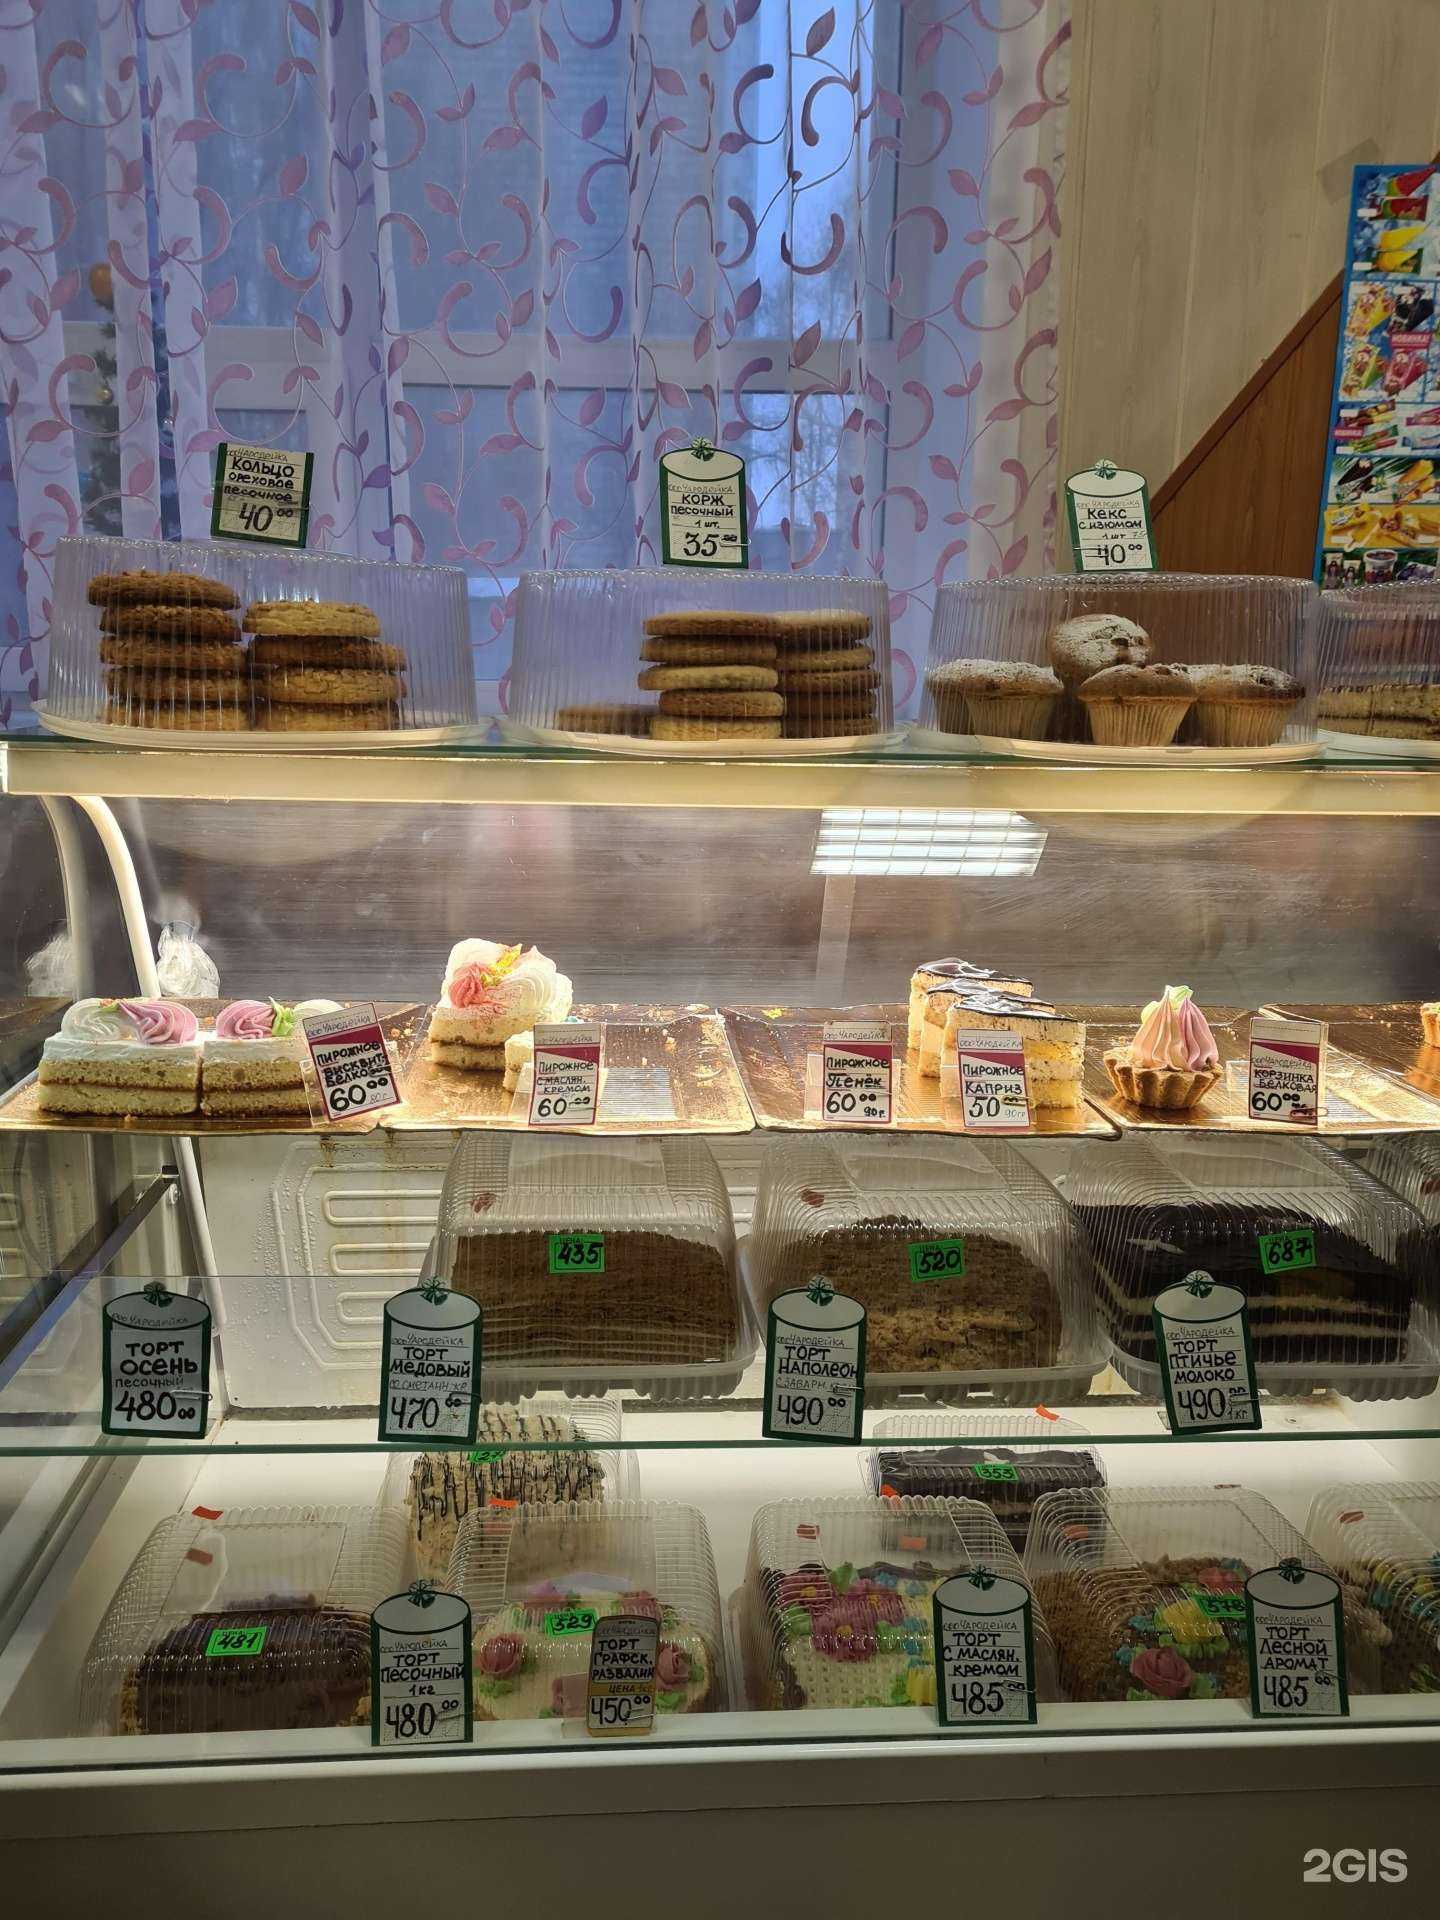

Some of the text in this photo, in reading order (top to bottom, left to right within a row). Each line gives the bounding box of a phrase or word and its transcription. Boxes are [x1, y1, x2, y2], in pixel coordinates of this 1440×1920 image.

[239, 502, 293, 532] 40 00
[695, 520, 702, 528] 1
[684, 533, 719, 557] 35
[1096, 543, 1142, 565] 40 00
[329, 1077, 388, 1111] 60 00
[826, 1091, 877, 1114] 60 00
[1252, 1091, 1300, 1112] 60 00
[538, 1097, 567, 1117] 60
[968, 1096, 1000, 1119] 50
[557, 1242, 604, 1265] 435
[918, 1249, 961, 1274] 520
[1268, 1237, 1313, 1264] 687
[125, 1341, 185, 1357] ТОРТ
[403, 1346, 449, 1361] ТОРТ
[784, 1345, 831, 1361] ТОРТ
[1172, 1339, 1218, 1354] ТОРТ
[115, 1390, 196, 1422] 480 00
[391, 1397, 462, 1429] 470 00
[778, 1395, 846, 1426] 490 00
[1176, 1387, 1226, 1422] 490
[217, 1632, 258, 1650] 481
[598, 1638, 640, 1651] ТОРТ
[951, 1631, 1001, 1647] ТОРТ
[1266, 1626, 1310, 1640] ТОРТ
[393, 1652, 441, 1666] ТОРТ
[1263, 1656, 1328, 1671] АРОМАТ
[408, 1685, 417, 1696] 1
[951, 1680, 1004, 1716] 485
[1263, 1674, 1331, 1708] 485 00
[385, 1699, 460, 1740] 480 00
[591, 1695, 651, 1725] 450 00
